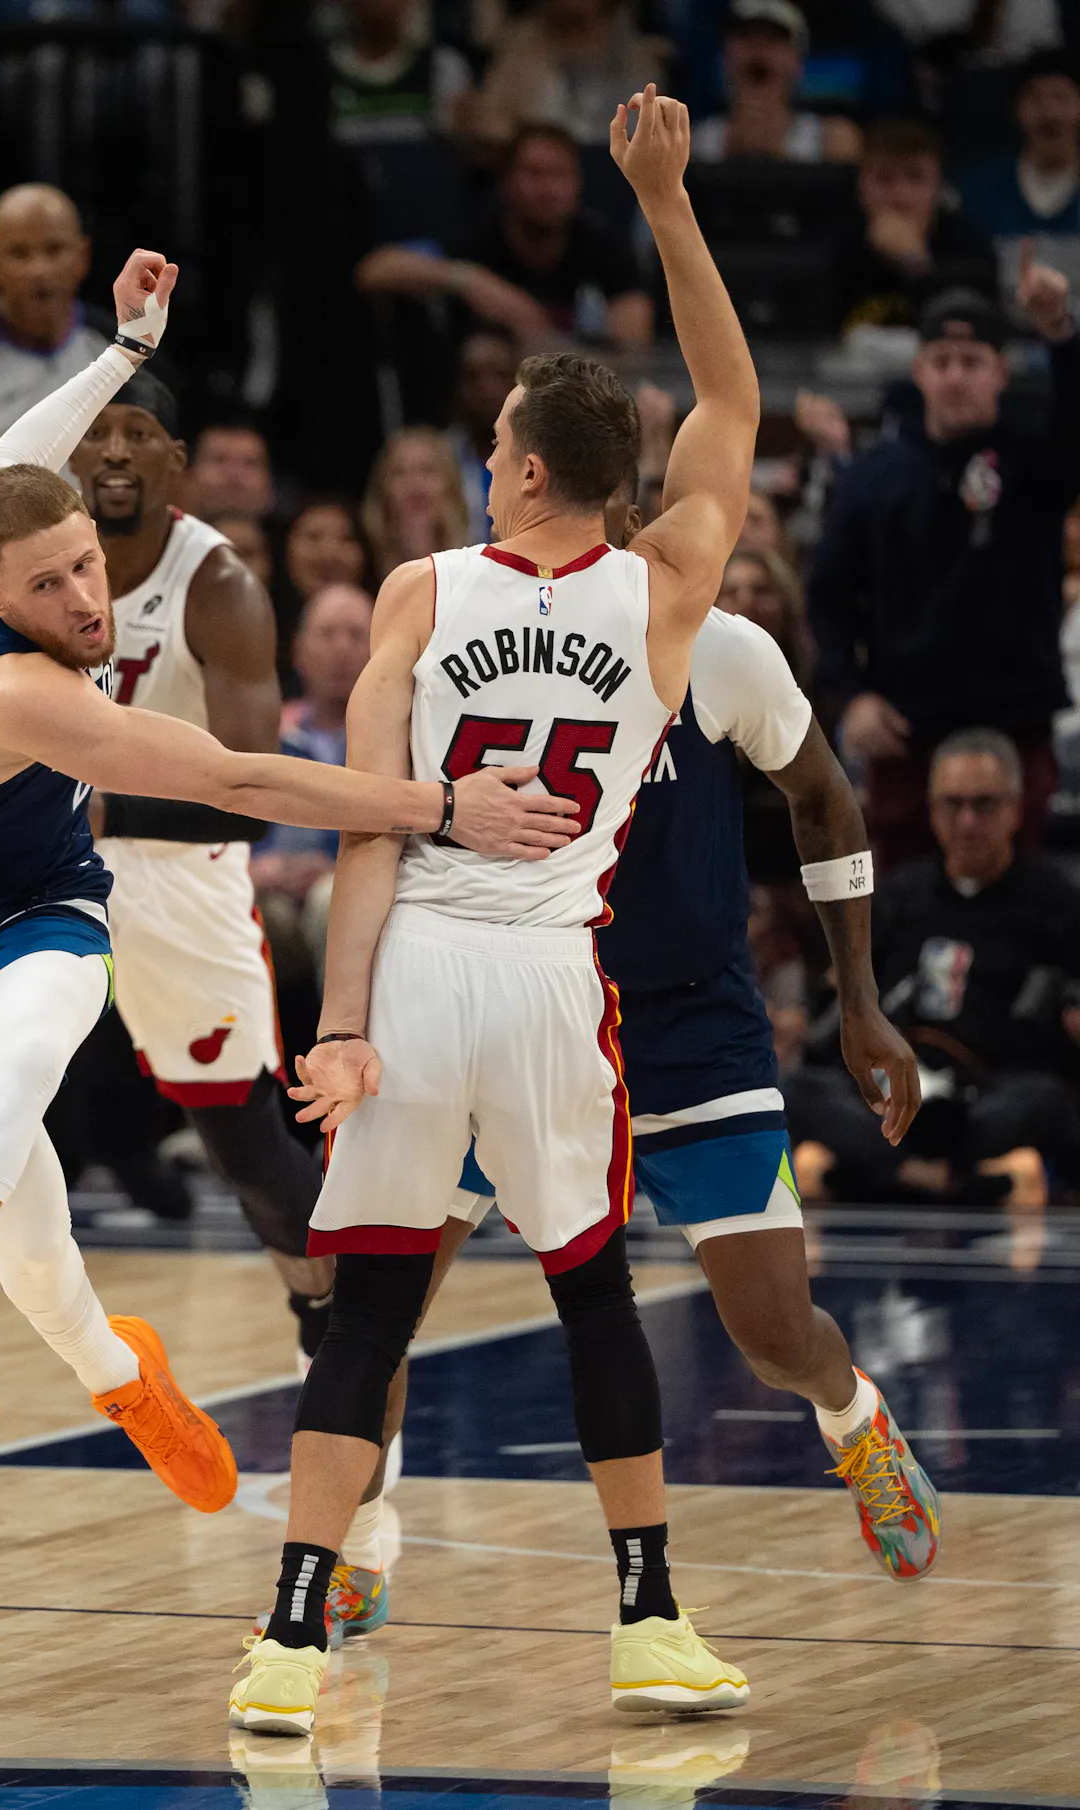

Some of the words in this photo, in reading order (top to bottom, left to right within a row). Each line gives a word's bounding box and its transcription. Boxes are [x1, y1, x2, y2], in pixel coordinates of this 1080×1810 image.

[440, 626, 632, 703] ROBINSON
[851, 859, 864, 875] 11
[848, 876, 866, 891] NR
